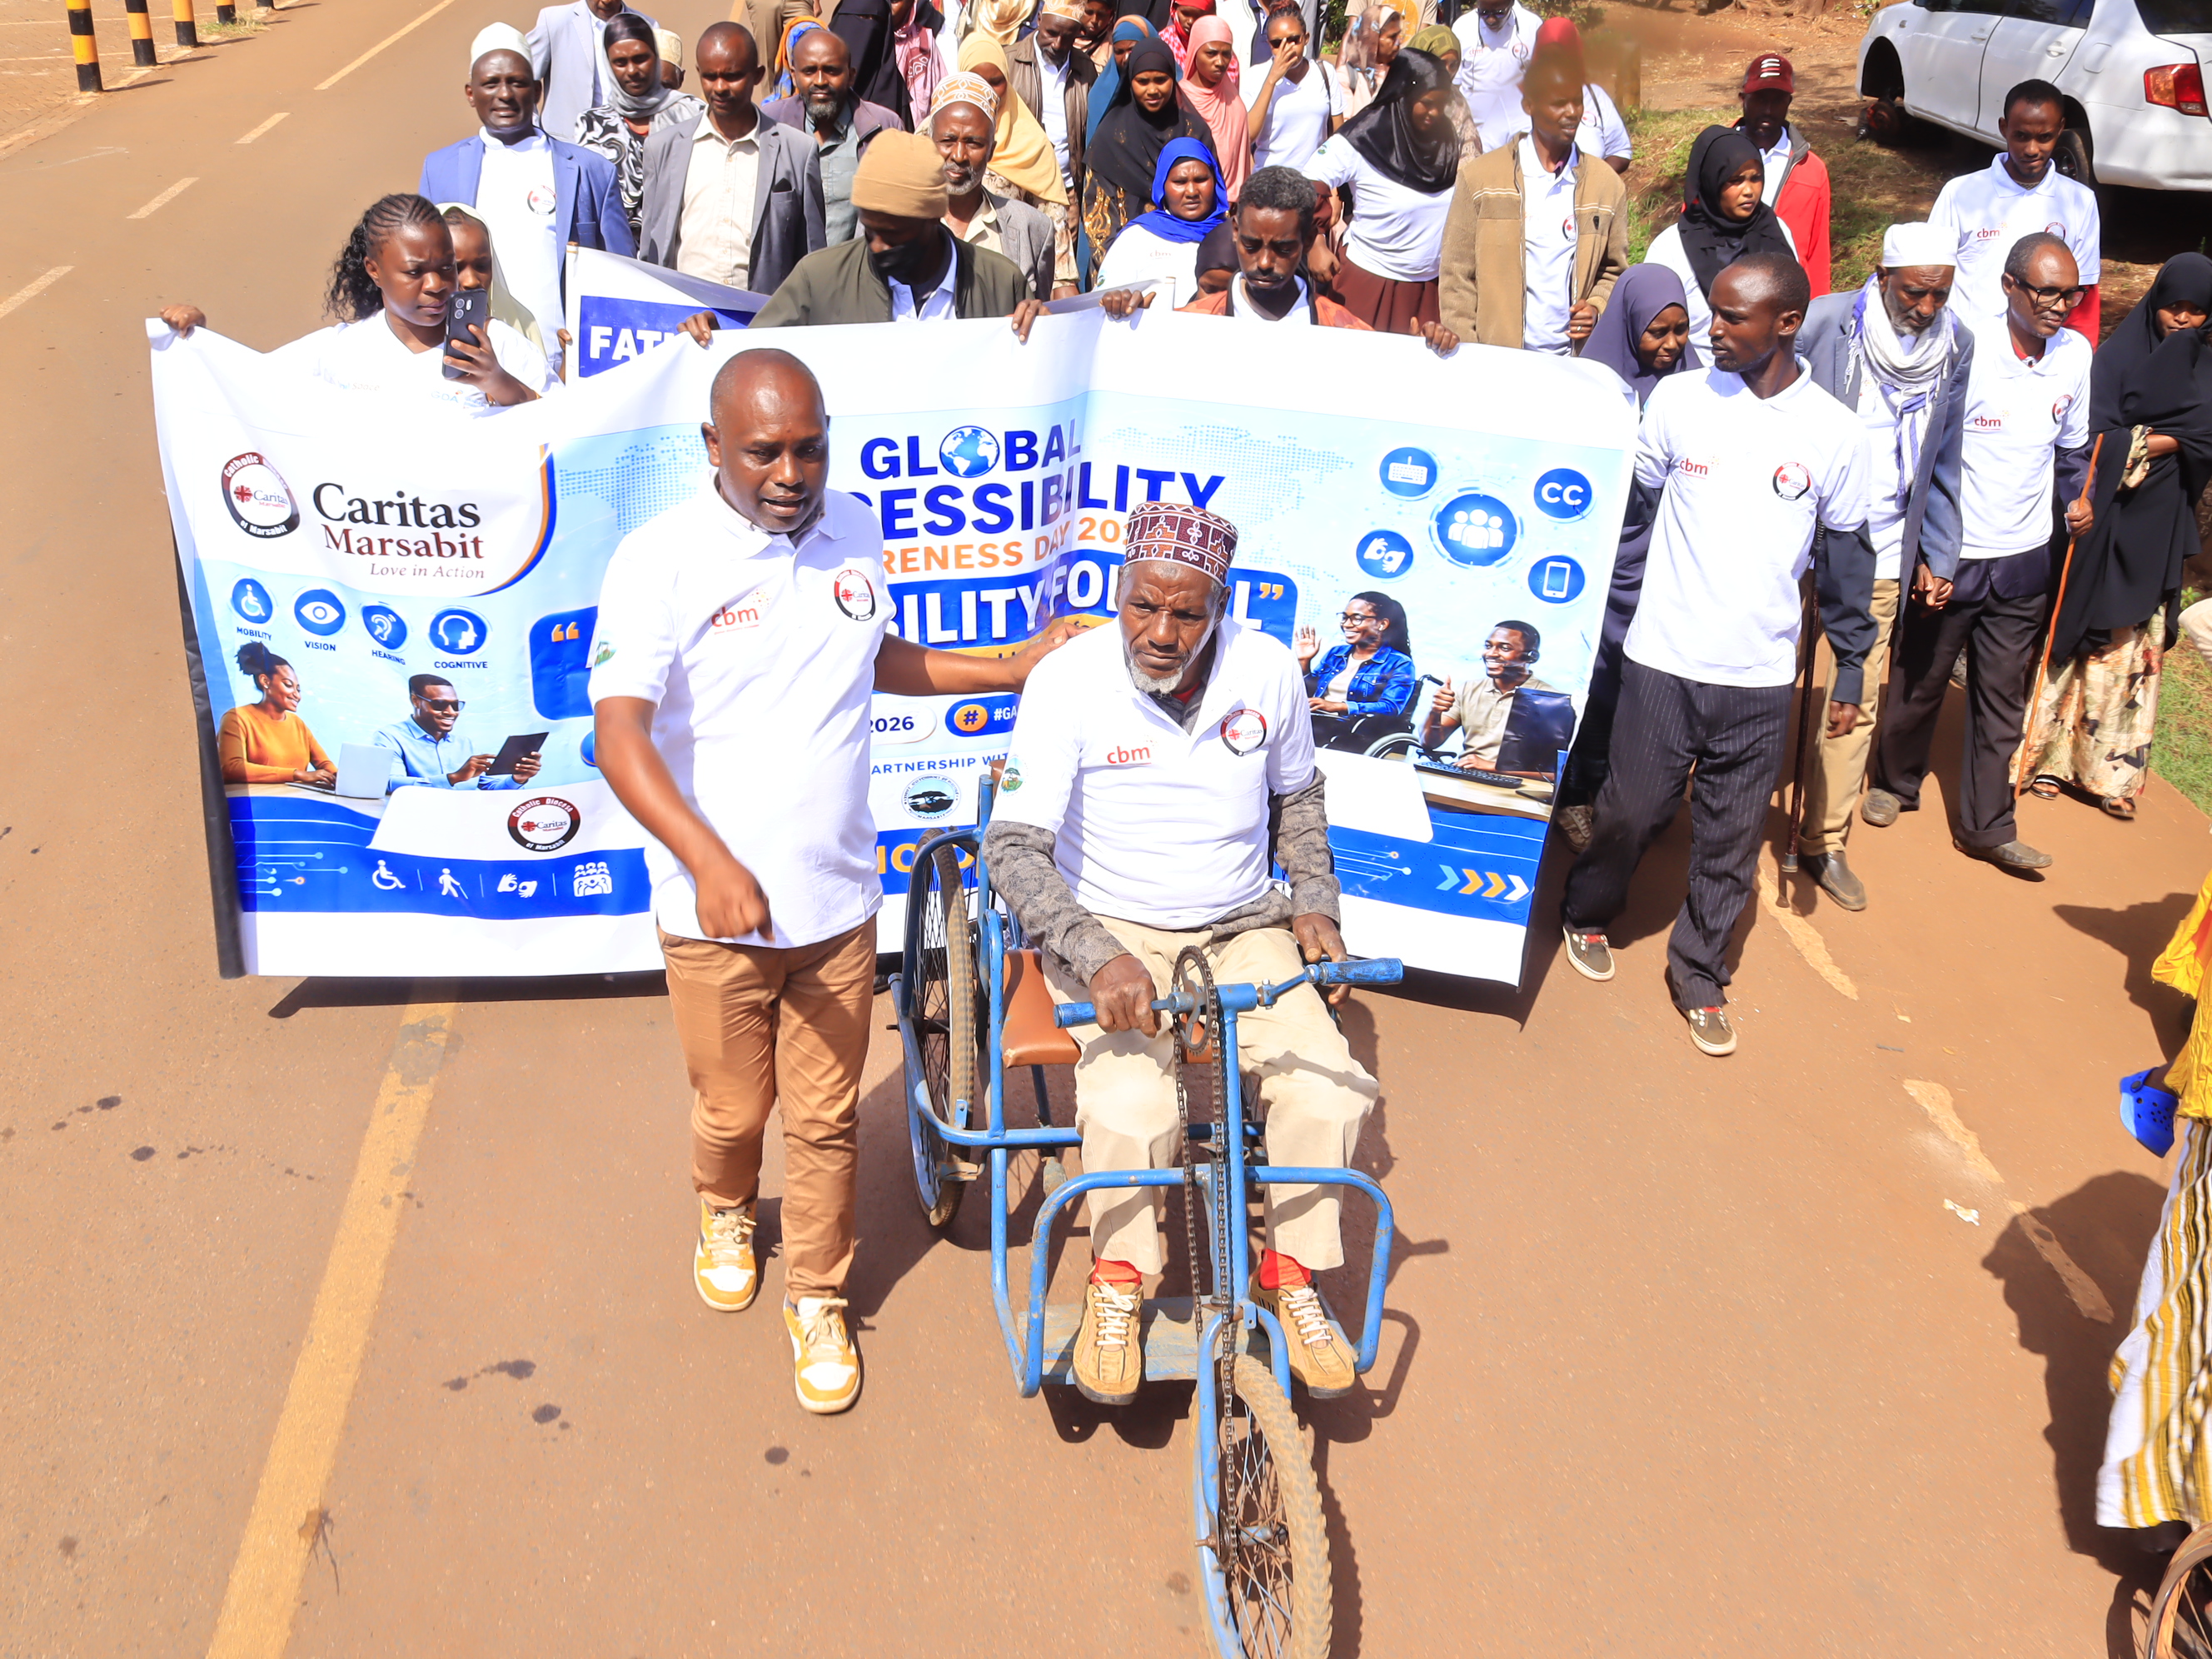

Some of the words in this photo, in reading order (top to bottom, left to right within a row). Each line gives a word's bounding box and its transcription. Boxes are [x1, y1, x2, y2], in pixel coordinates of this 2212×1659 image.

[1976, 228, 2000, 238] cbm
[590, 326, 675, 361] FAT
[1974, 416, 2001, 427] cbm
[223, 453, 261, 478] Catholic
[1679, 457, 1708, 476] cbm
[848, 461, 1226, 541] ESSIBILITY
[1541, 481, 1584, 506] CC
[312, 481, 481, 529] Caritas
[249, 523, 289, 536] Marsabit
[1034, 520, 1072, 561] DAY
[1078, 516, 1128, 546] 20
[321, 523, 485, 560] Marsabit
[370, 562, 407, 576] Love
[412, 564, 428, 576] in
[432, 565, 485, 579] Action
[711, 606, 759, 627] cbm
[884, 579, 1046, 644] ILITY
[237, 625, 272, 641] MOBILITY
[304, 640, 336, 651] VISION
[371, 650, 406, 665] HEARING
[434, 660, 488, 669] COGNITIVE
[1107, 745, 1150, 764] cbm
[871, 757, 976, 775] ARTNERSHIP
[511, 800, 541, 818] Catholic
[545, 798, 574, 813] Diocese
[536, 820, 568, 830] Caritas
